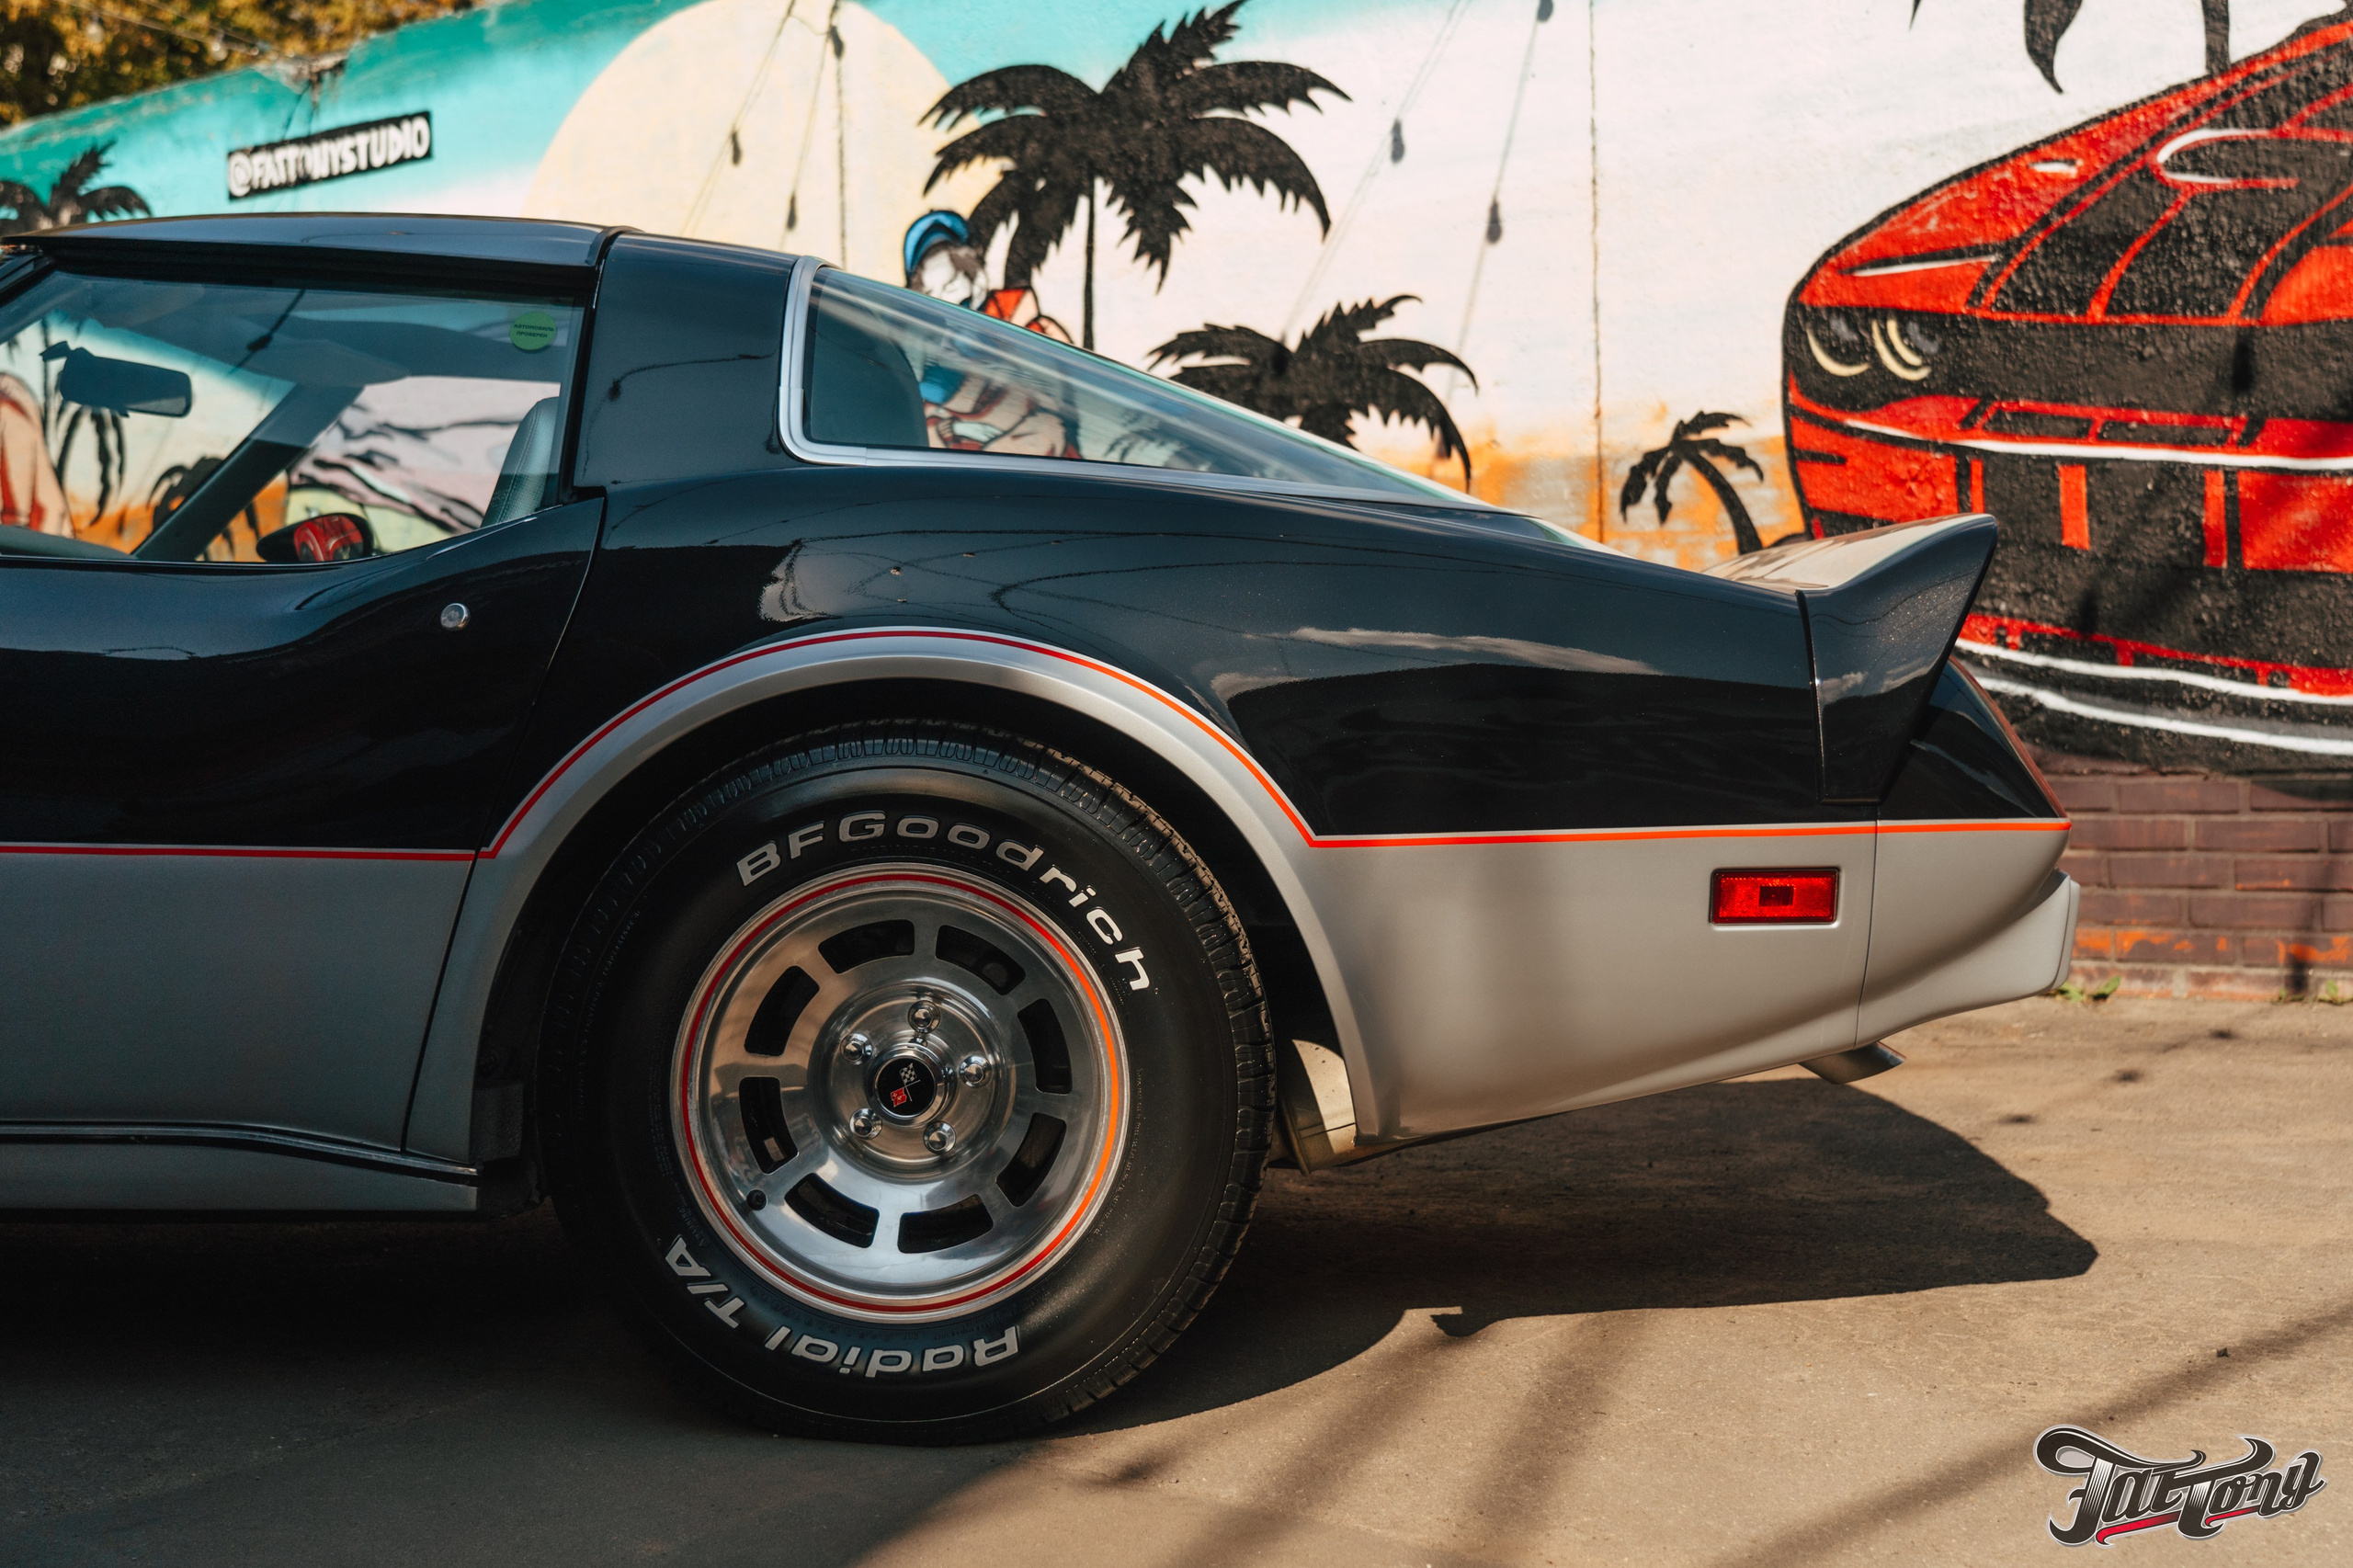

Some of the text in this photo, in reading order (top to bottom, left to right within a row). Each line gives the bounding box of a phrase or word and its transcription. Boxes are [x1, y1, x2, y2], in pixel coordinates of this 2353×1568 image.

[229, 116, 430, 197] @FATTONYSTUDIO
[513, 324, 555, 332] АВТОМОБИЛЬ
[737, 812, 1152, 993] BFGoodrich
[665, 1236, 747, 1330] T/A
[765, 1325, 1019, 1379] Radial
